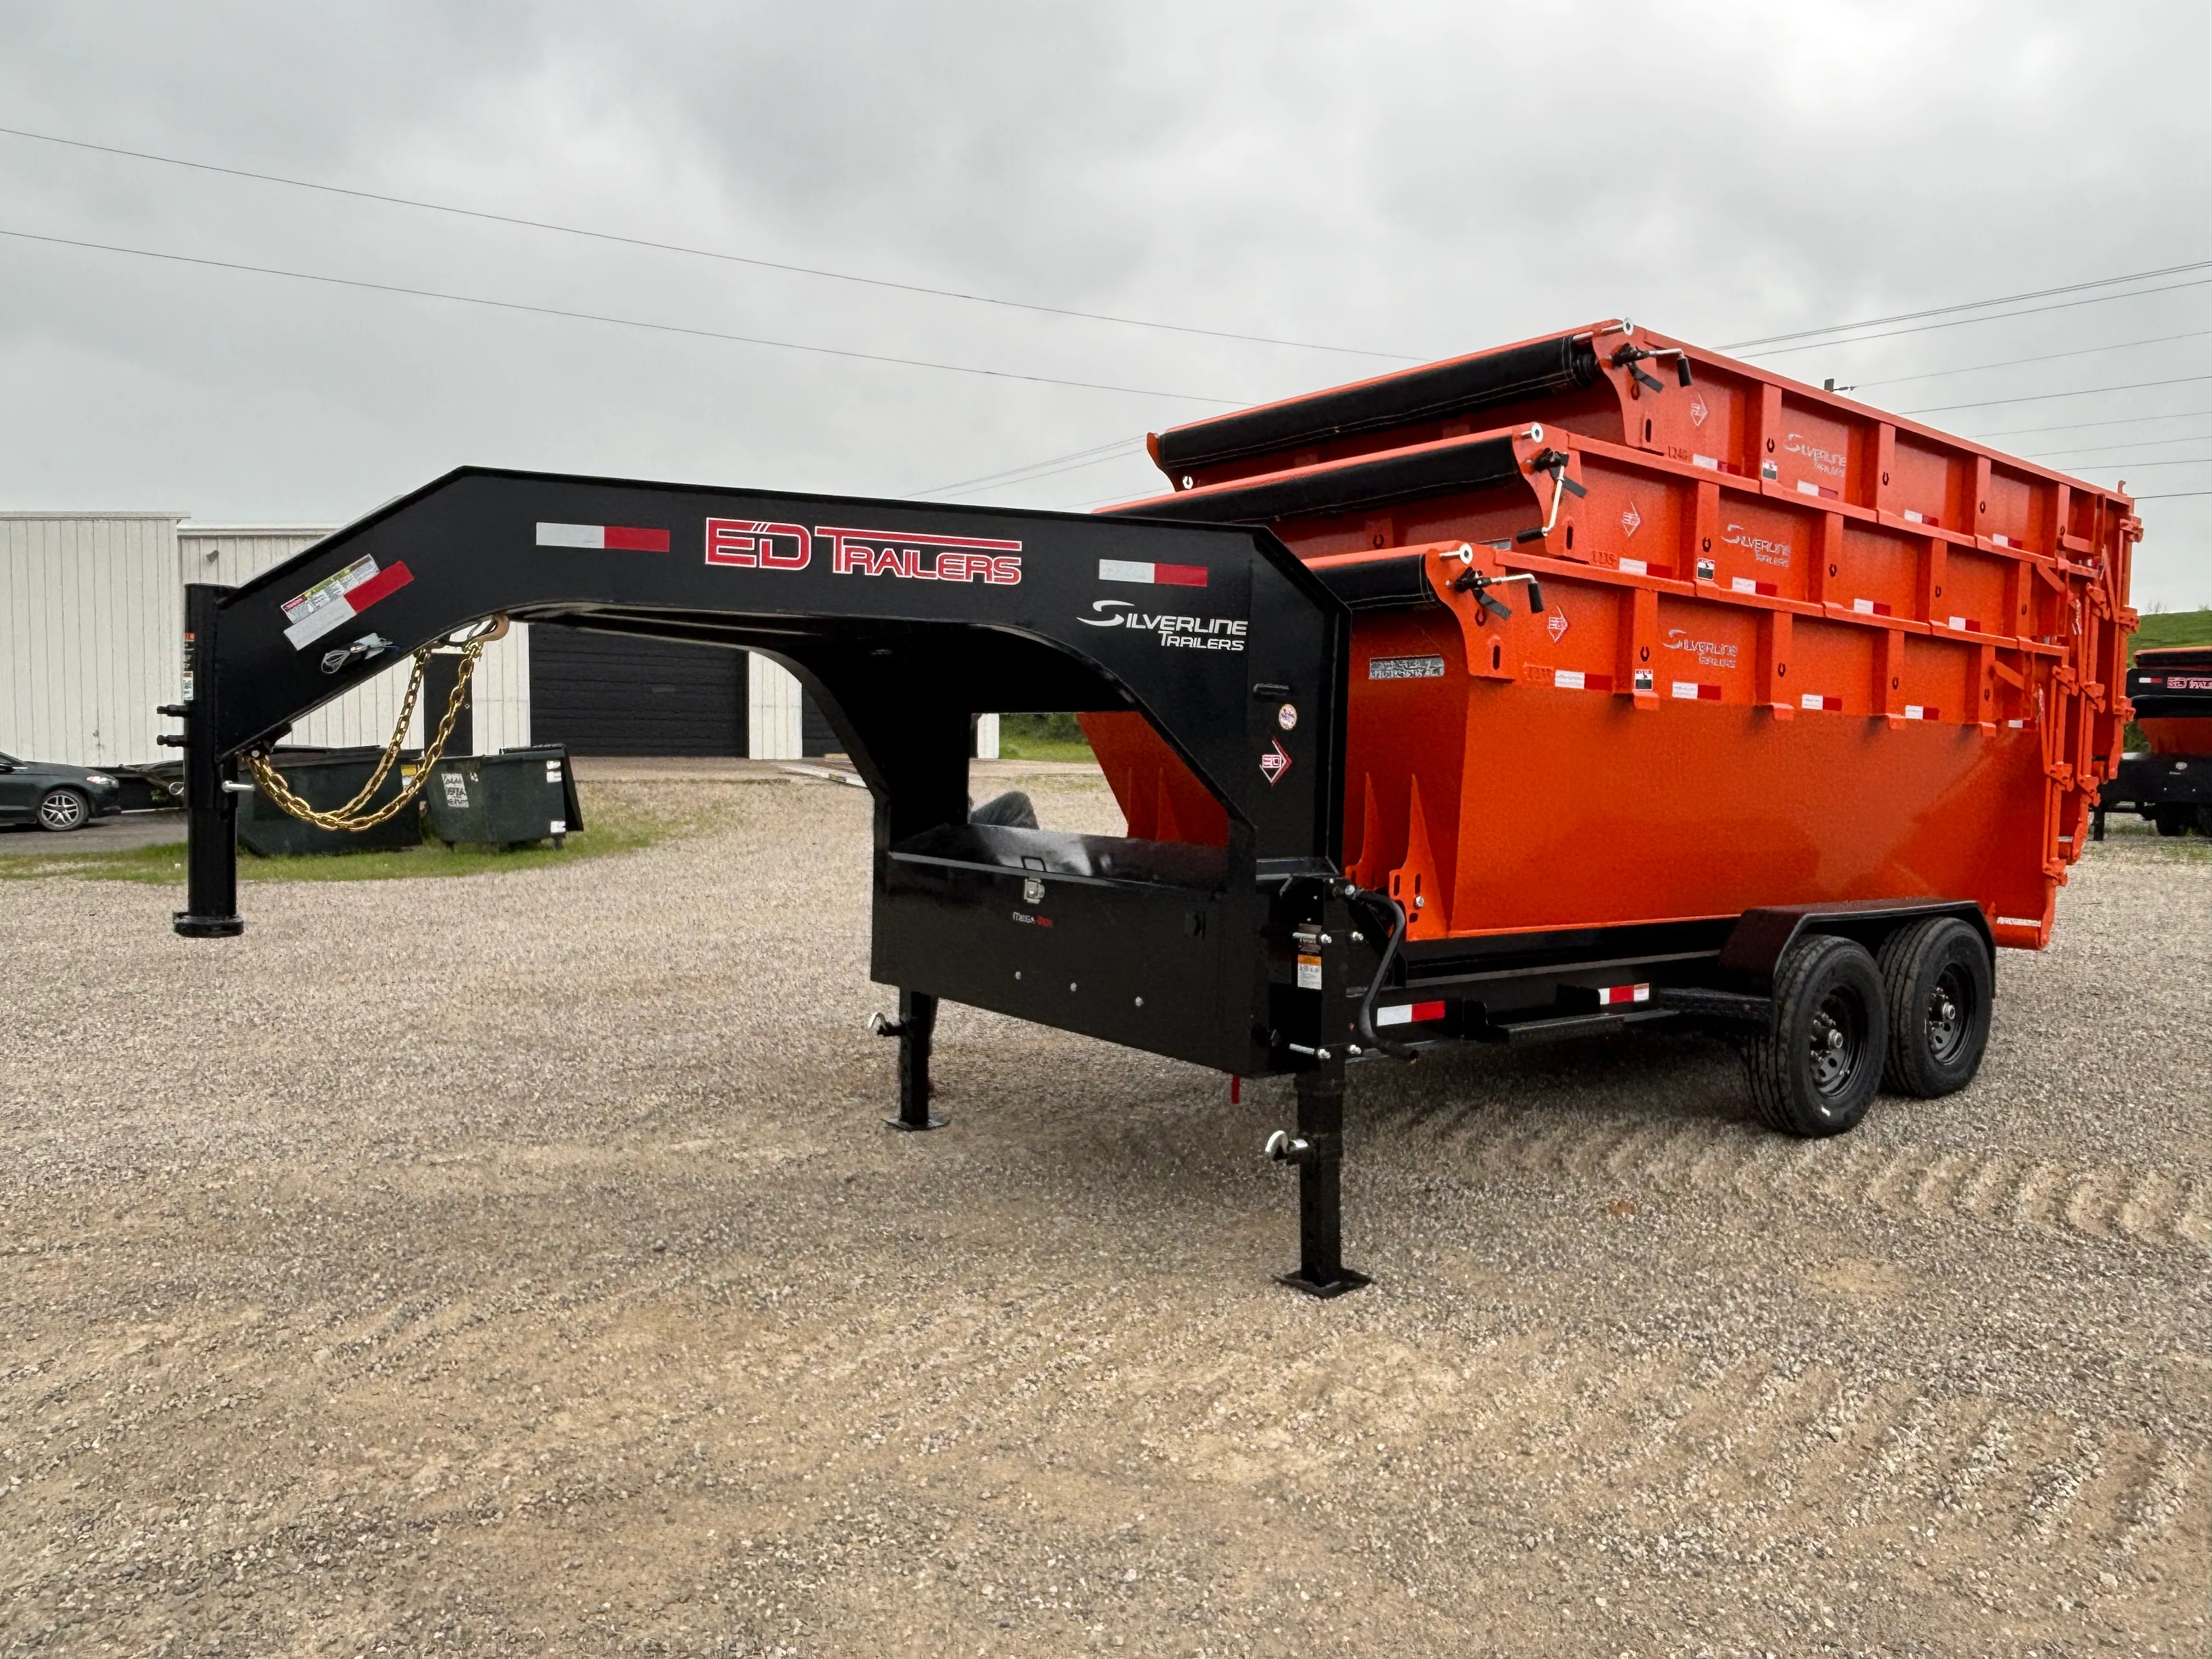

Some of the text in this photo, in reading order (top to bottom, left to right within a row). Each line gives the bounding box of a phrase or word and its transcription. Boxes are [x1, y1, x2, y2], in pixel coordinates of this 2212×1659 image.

[705, 517, 1023, 585] ED TRAILERS
[1076, 600, 1249, 635] SILVERLINE
[1158, 630, 1245, 651] TRAILERS
